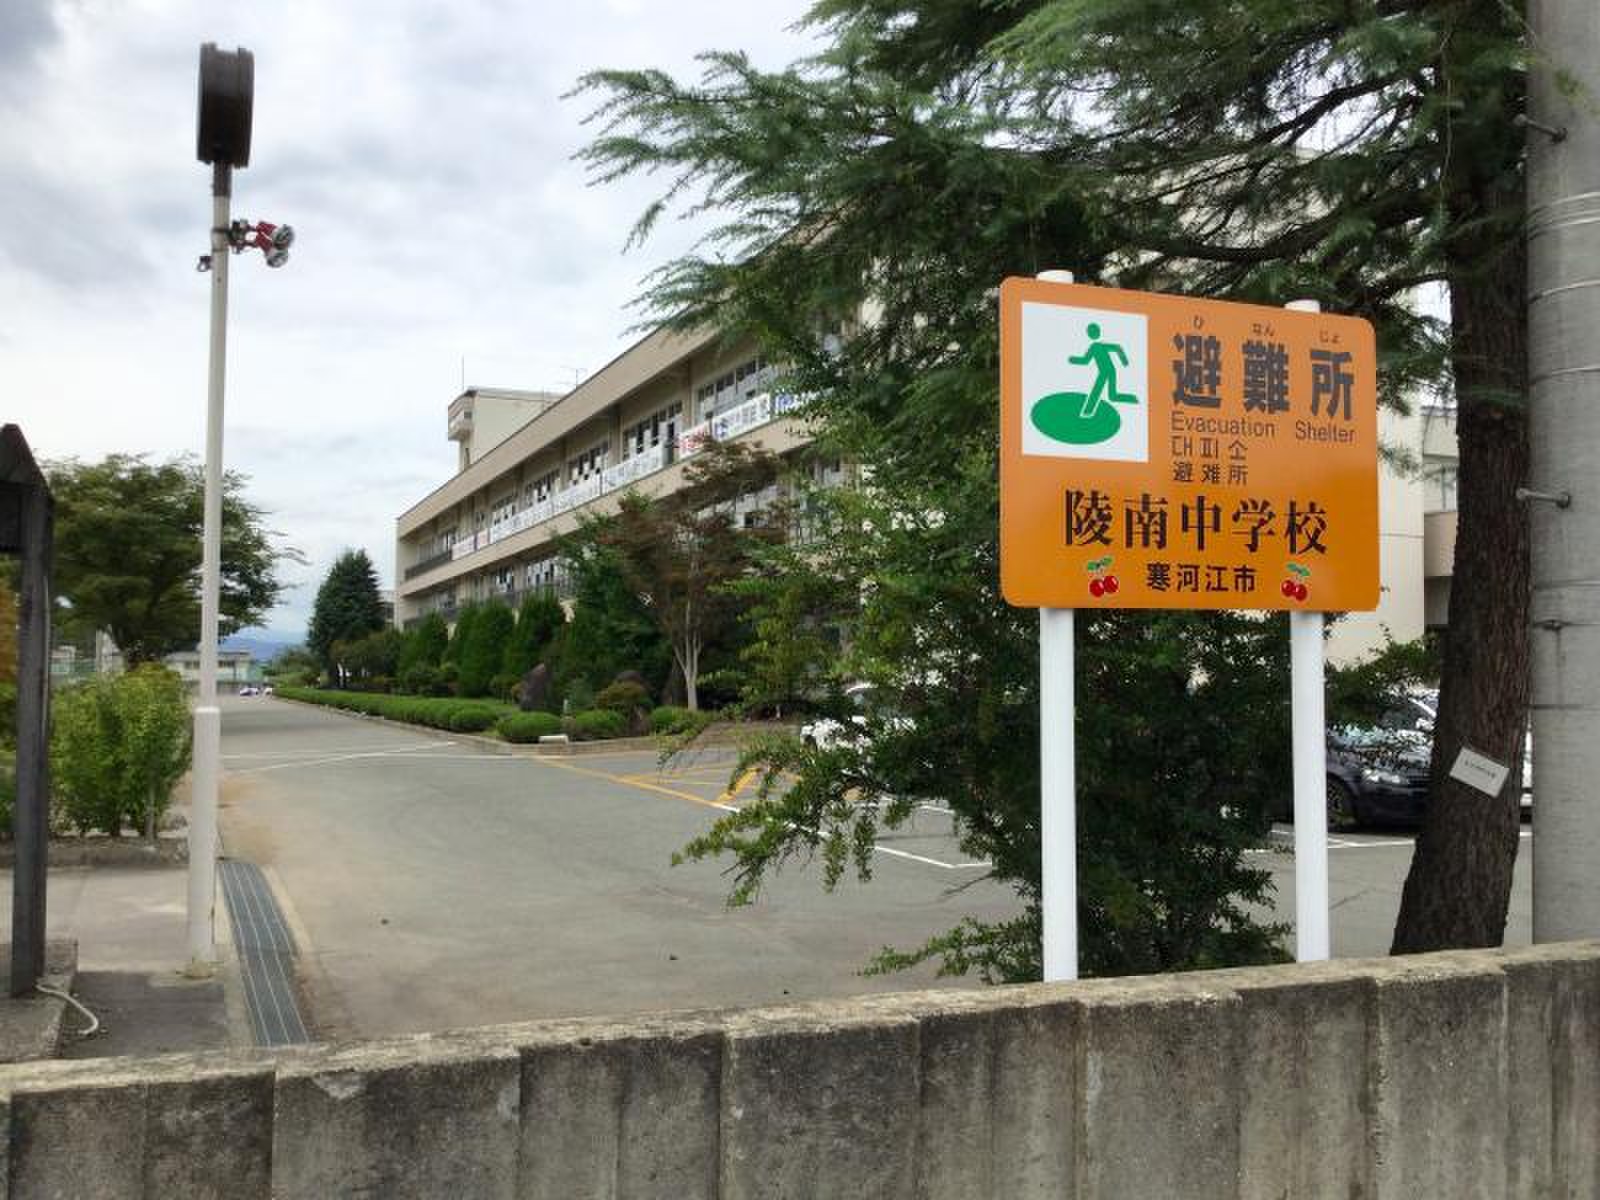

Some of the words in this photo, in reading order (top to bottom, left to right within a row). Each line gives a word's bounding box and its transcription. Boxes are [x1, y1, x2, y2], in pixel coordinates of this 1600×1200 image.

[1193, 315, 1205, 328] ひ
[1252, 323, 1275, 337] なん
[1172, 333, 1354, 421] 避難所
[1171, 411, 1275, 438] Evacuation
[1295, 420, 1355, 443] Shelter
[1172, 436, 1248, 461] 대피소
[1173, 461, 1248, 485] 避难所
[1065, 489, 1328, 555] 陵南中学校
[1146, 562, 1257, 592] 寒河江市
